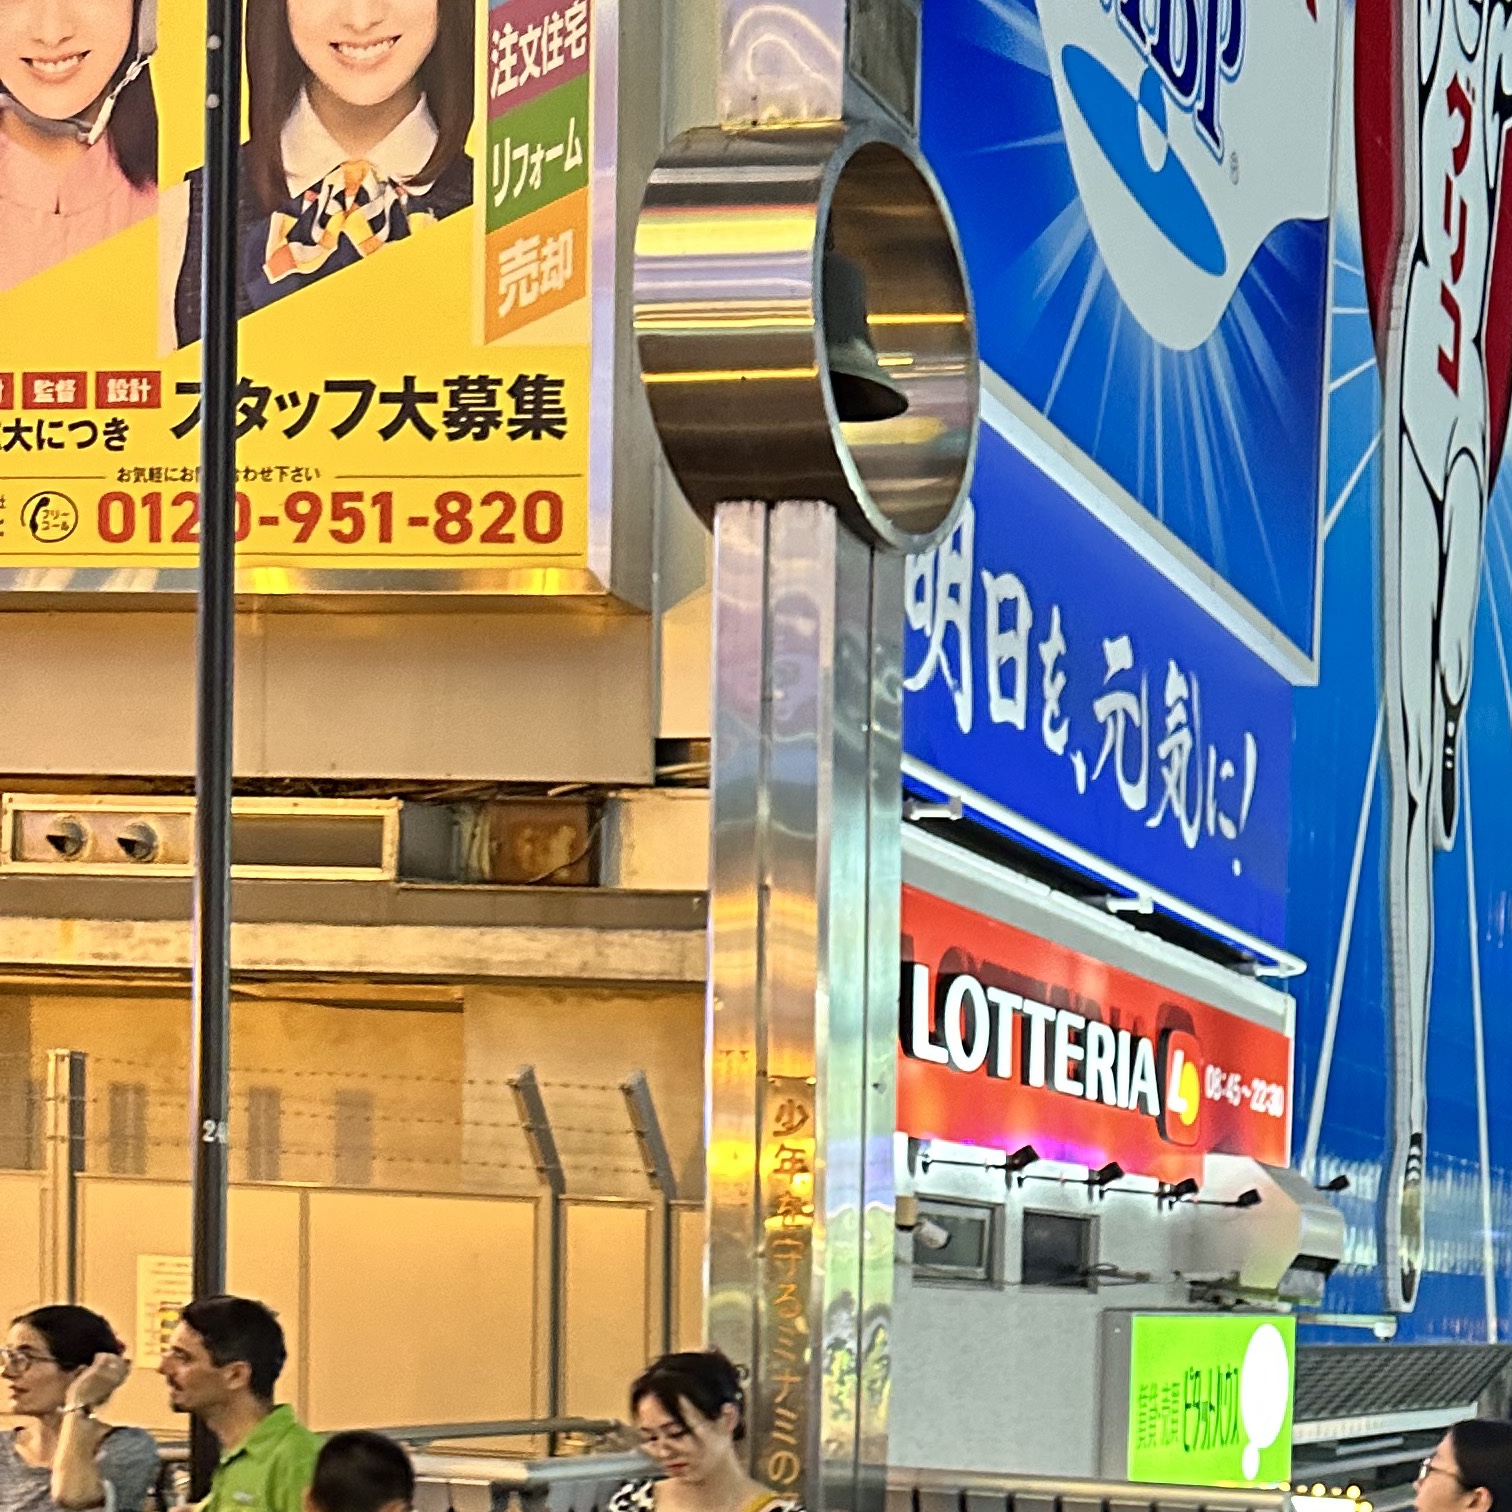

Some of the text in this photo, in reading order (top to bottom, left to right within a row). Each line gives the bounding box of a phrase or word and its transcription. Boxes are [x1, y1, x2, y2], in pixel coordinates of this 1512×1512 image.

[490, 0, 588, 100] 注文住宅
[492, 116, 583, 208] リフォーム
[498, 228, 575, 319] 売却
[1437, 70, 1476, 398] グリコ
[0, 417, 130, 452] 大につき
[106, 377, 152, 404] 設計
[116, 467, 321, 483] お気軽におわせ下さい
[911, 962, 1161, 1117] LOTTERIA
[767, 1098, 810, 1501] 少年を守るミナミの
